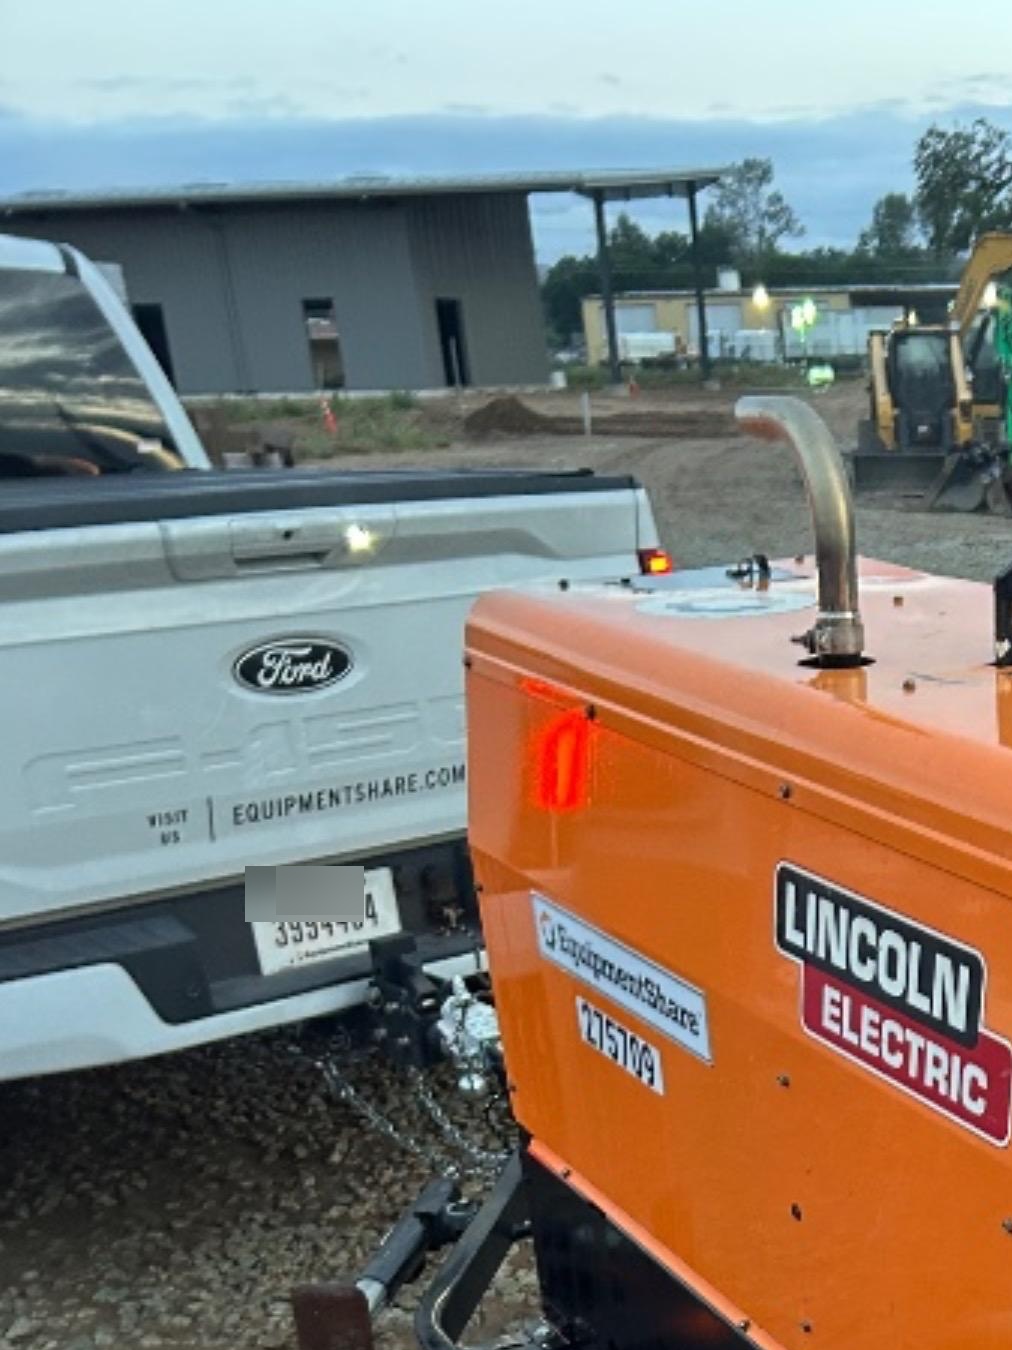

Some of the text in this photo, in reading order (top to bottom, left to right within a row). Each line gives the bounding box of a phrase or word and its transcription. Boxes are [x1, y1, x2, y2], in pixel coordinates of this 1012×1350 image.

[257, 646, 333, 687] Ford
[147, 809, 188, 828] VISIT
[232, 764, 466, 826] EQUIPMENTSHARE.COM
[160, 831, 181, 846] US
[557, 923, 700, 1037] EquipmentShare
[784, 881, 970, 1033] LINCOLN
[581, 1003, 655, 1087] 275709
[821, 982, 988, 1117] ELECTRIC
